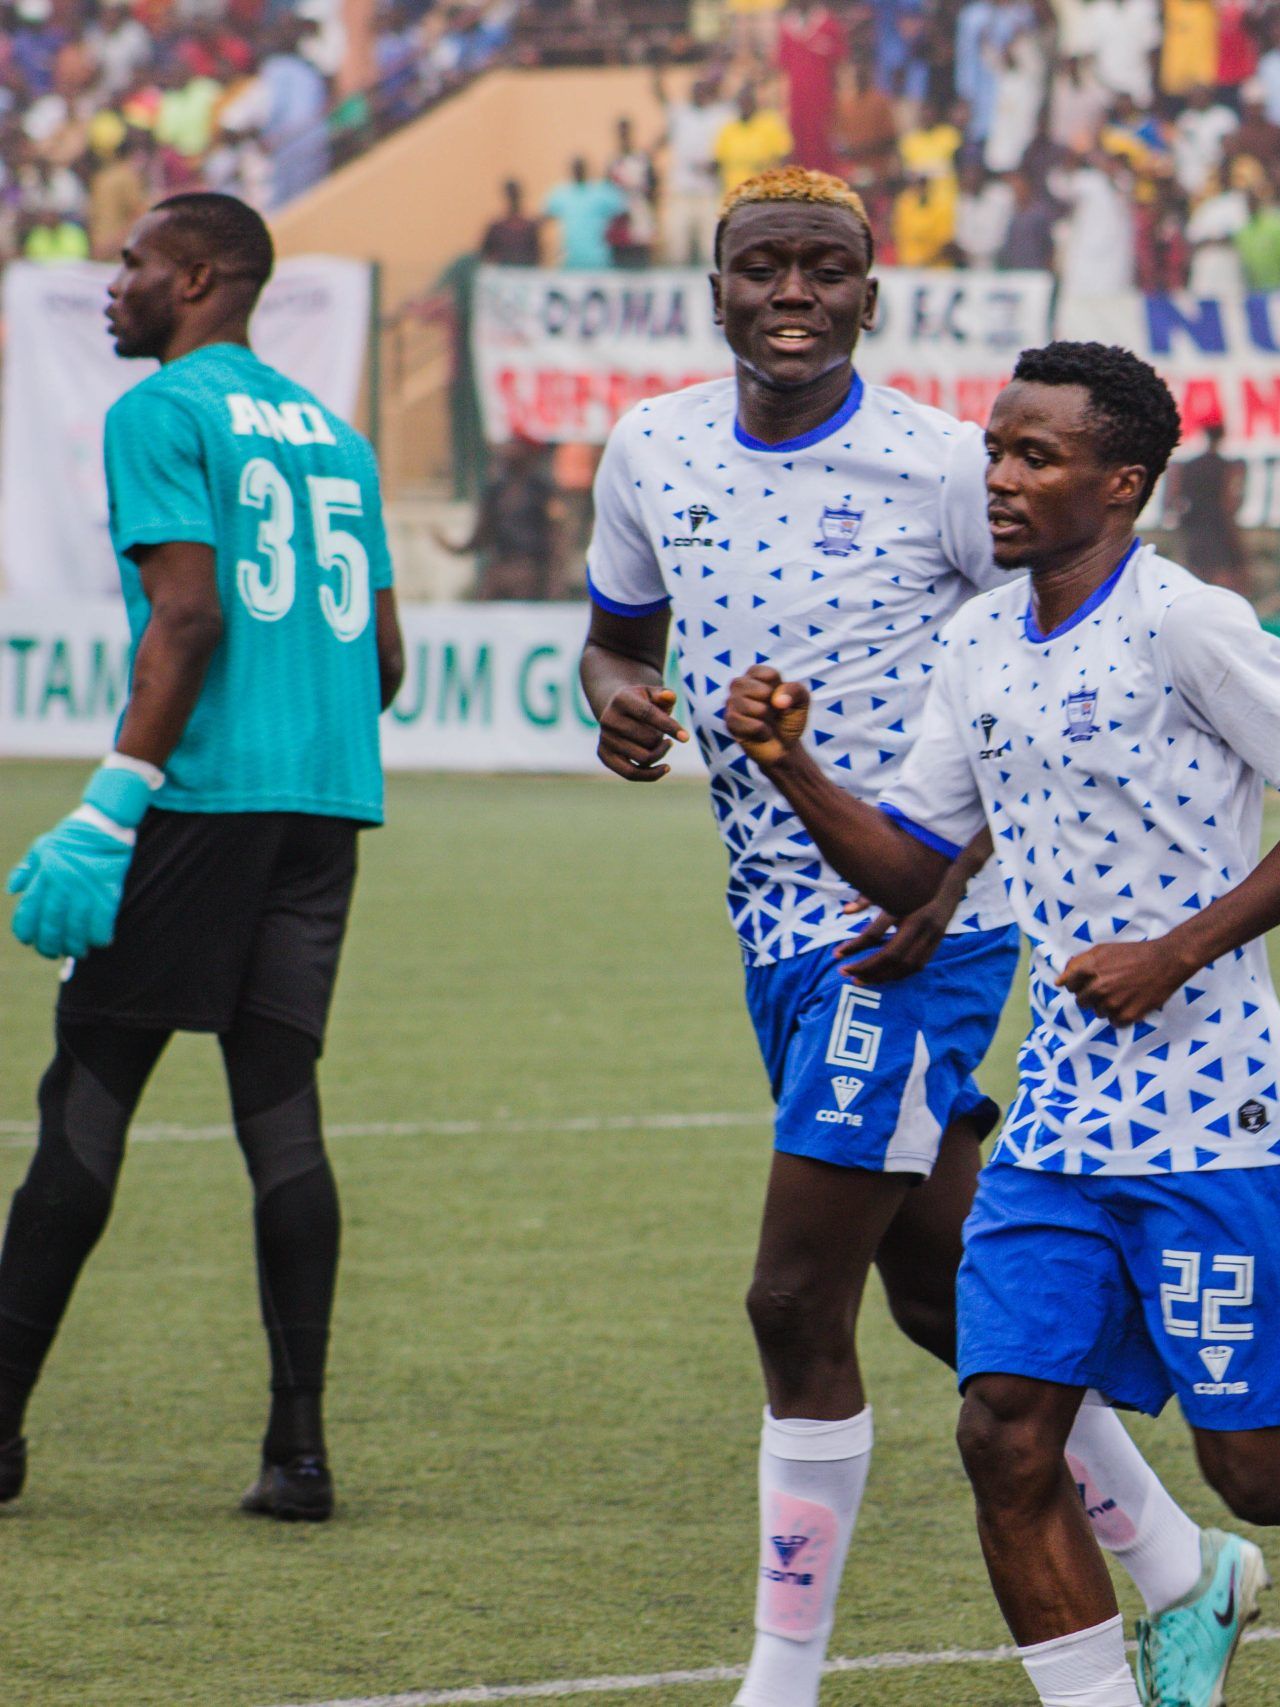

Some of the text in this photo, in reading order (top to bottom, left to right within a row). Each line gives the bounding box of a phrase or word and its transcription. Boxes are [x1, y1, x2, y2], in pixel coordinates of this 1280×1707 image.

[236, 456, 371, 643] 35
[392, 642, 494, 726] UM
[825, 983, 883, 1072] 6
[815, 1109, 864, 1127] cone
[1160, 1249, 1255, 1340] 22
[1193, 1381, 1249, 1396] cone
